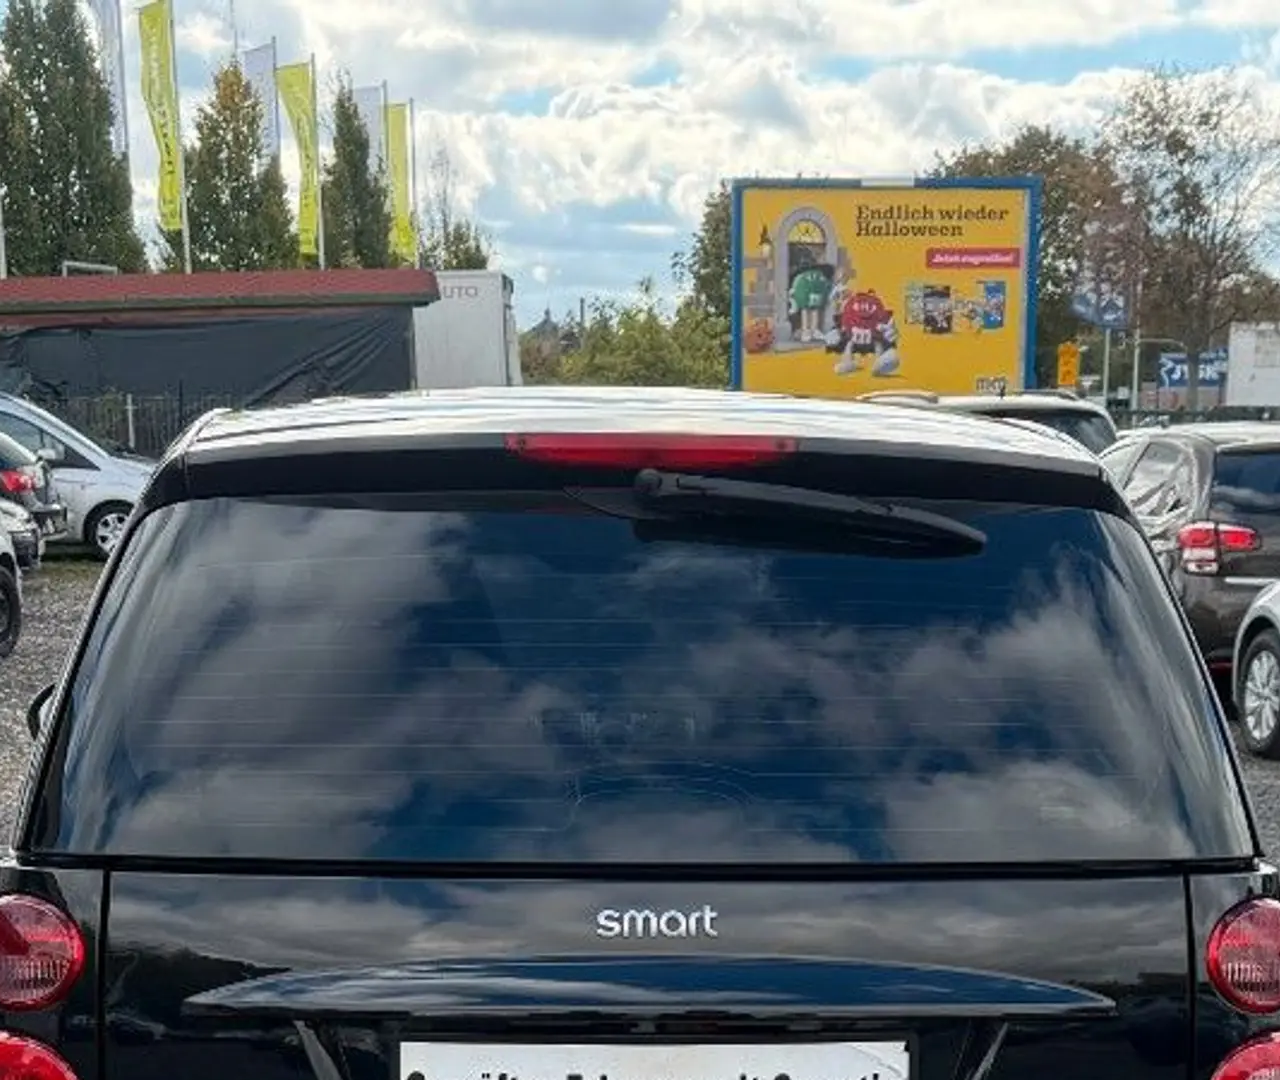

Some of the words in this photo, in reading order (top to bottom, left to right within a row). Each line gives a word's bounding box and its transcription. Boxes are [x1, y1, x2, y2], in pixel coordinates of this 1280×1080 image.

[856, 204, 934, 220] Endlich
[940, 204, 1009, 220] wieder
[856, 220, 963, 236] Halloween
[597, 904, 718, 937] smart
